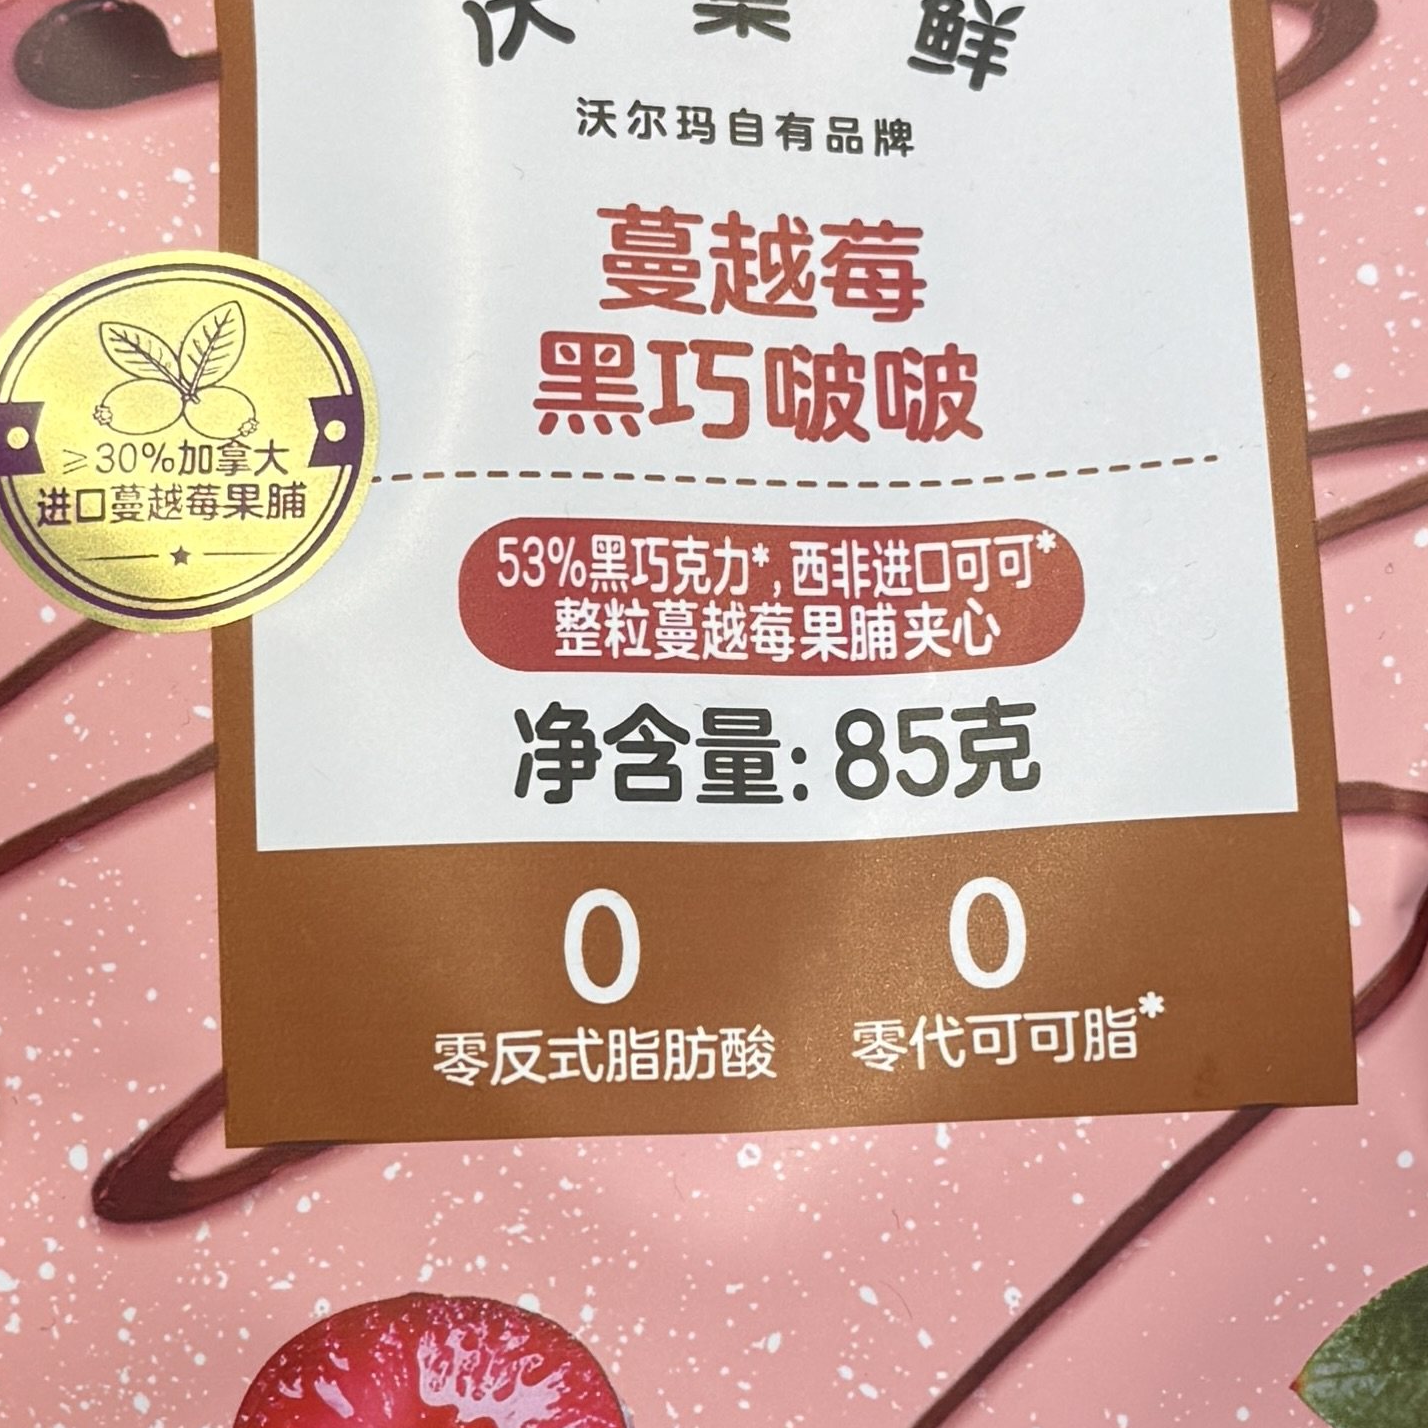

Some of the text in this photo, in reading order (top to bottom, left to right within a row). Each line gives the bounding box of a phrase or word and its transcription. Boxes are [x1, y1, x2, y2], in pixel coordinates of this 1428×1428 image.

[576, 96, 916, 157] 沃尔玛自有品牌
[596, 203, 928, 322] 蔓越莓
[533, 330, 984, 443] 黑巧啵啵
[36, 481, 307, 529] 进口蔓越莓果脯
[554, 596, 1002, 663] 整粒蔓越莓果脯夹心
[563, 888, 641, 1005] 0
[948, 876, 1028, 990] 0
[432, 1026, 778, 1088] 零反式脂肪酸
